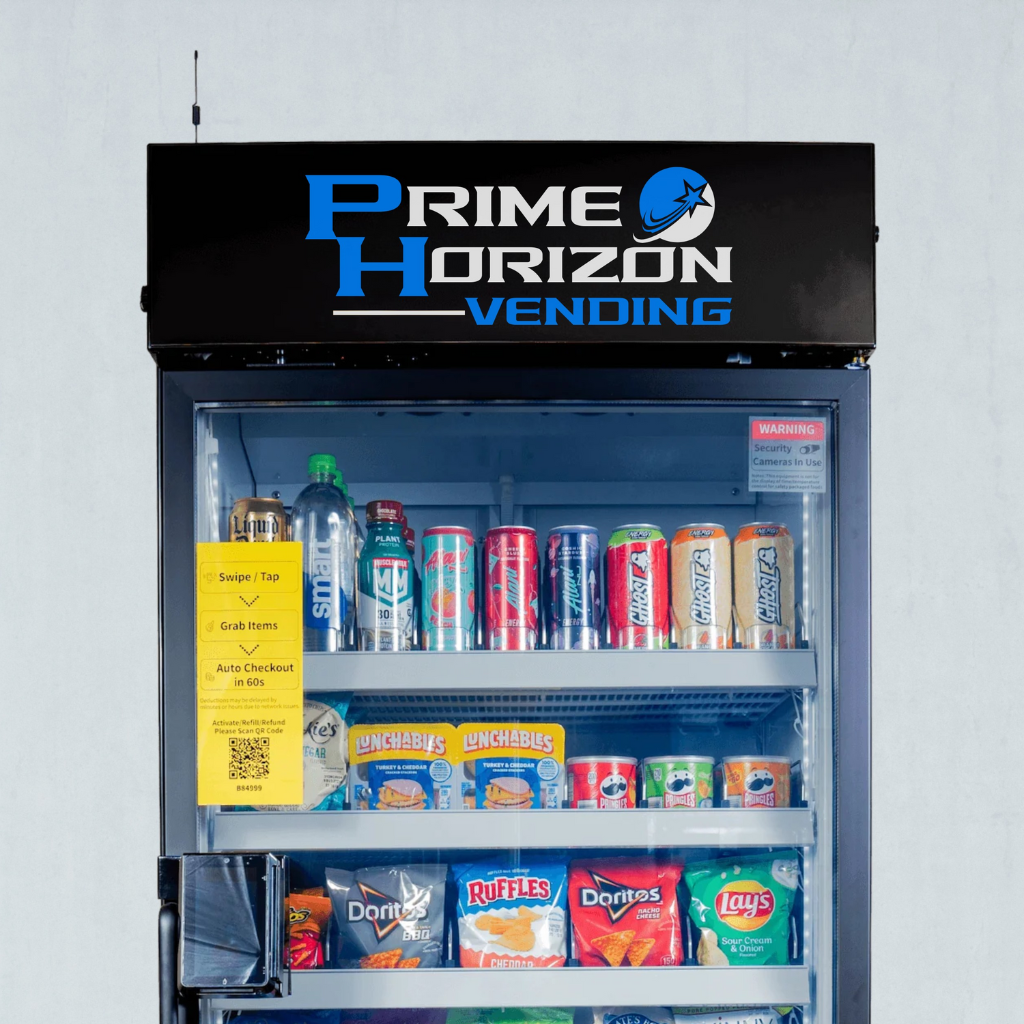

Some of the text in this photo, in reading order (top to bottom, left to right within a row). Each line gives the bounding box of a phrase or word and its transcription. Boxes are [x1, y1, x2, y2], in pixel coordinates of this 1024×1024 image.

[305, 174, 623, 240] PRIME
[335, 237, 733, 297] HORIZON
[465, 297, 733, 326] VENDING
[759, 423, 815, 435] WARNING
[754, 443, 793, 455] Security
[753, 457, 822, 467] Cameras In Use
[234, 512, 279, 538] Liquid
[753, 527, 779, 536] ENERGY
[375, 535, 400, 543] PLANT
[625, 530, 651, 538] ENERGY
[688, 529, 714, 537] ENERGY
[219, 571, 251, 584] Swipe
[261, 571, 280, 583] Tap
[312, 538, 333, 619] smart
[628, 561, 653, 626] GHOST
[690, 558, 716, 625] GHOST
[755, 556, 782, 626] GHOST
[220, 620, 278, 630] Grab Items
[216, 662, 294, 673] Auto Checkout
[234, 677, 265, 687] in 60s
[212, 719, 286, 727] Activate/Refill/Refund
[356, 731, 446, 756] LUNCHABLES
[463, 729, 554, 755] LUNCHABLES
[304, 746, 327, 759] EGAR
[665, 791, 696, 808] PRINGLES
[744, 792, 775, 808] PRINGLES
[467, 876, 551, 906] RUFFLES
[582, 887, 661, 906] Doritos
[347, 901, 428, 922] Doritos
[720, 891, 771, 919] Lay's
[402, 929, 431, 941] BBQ
[721, 936, 772, 945] Sour Cream
[730, 944, 764, 952] & Onion
